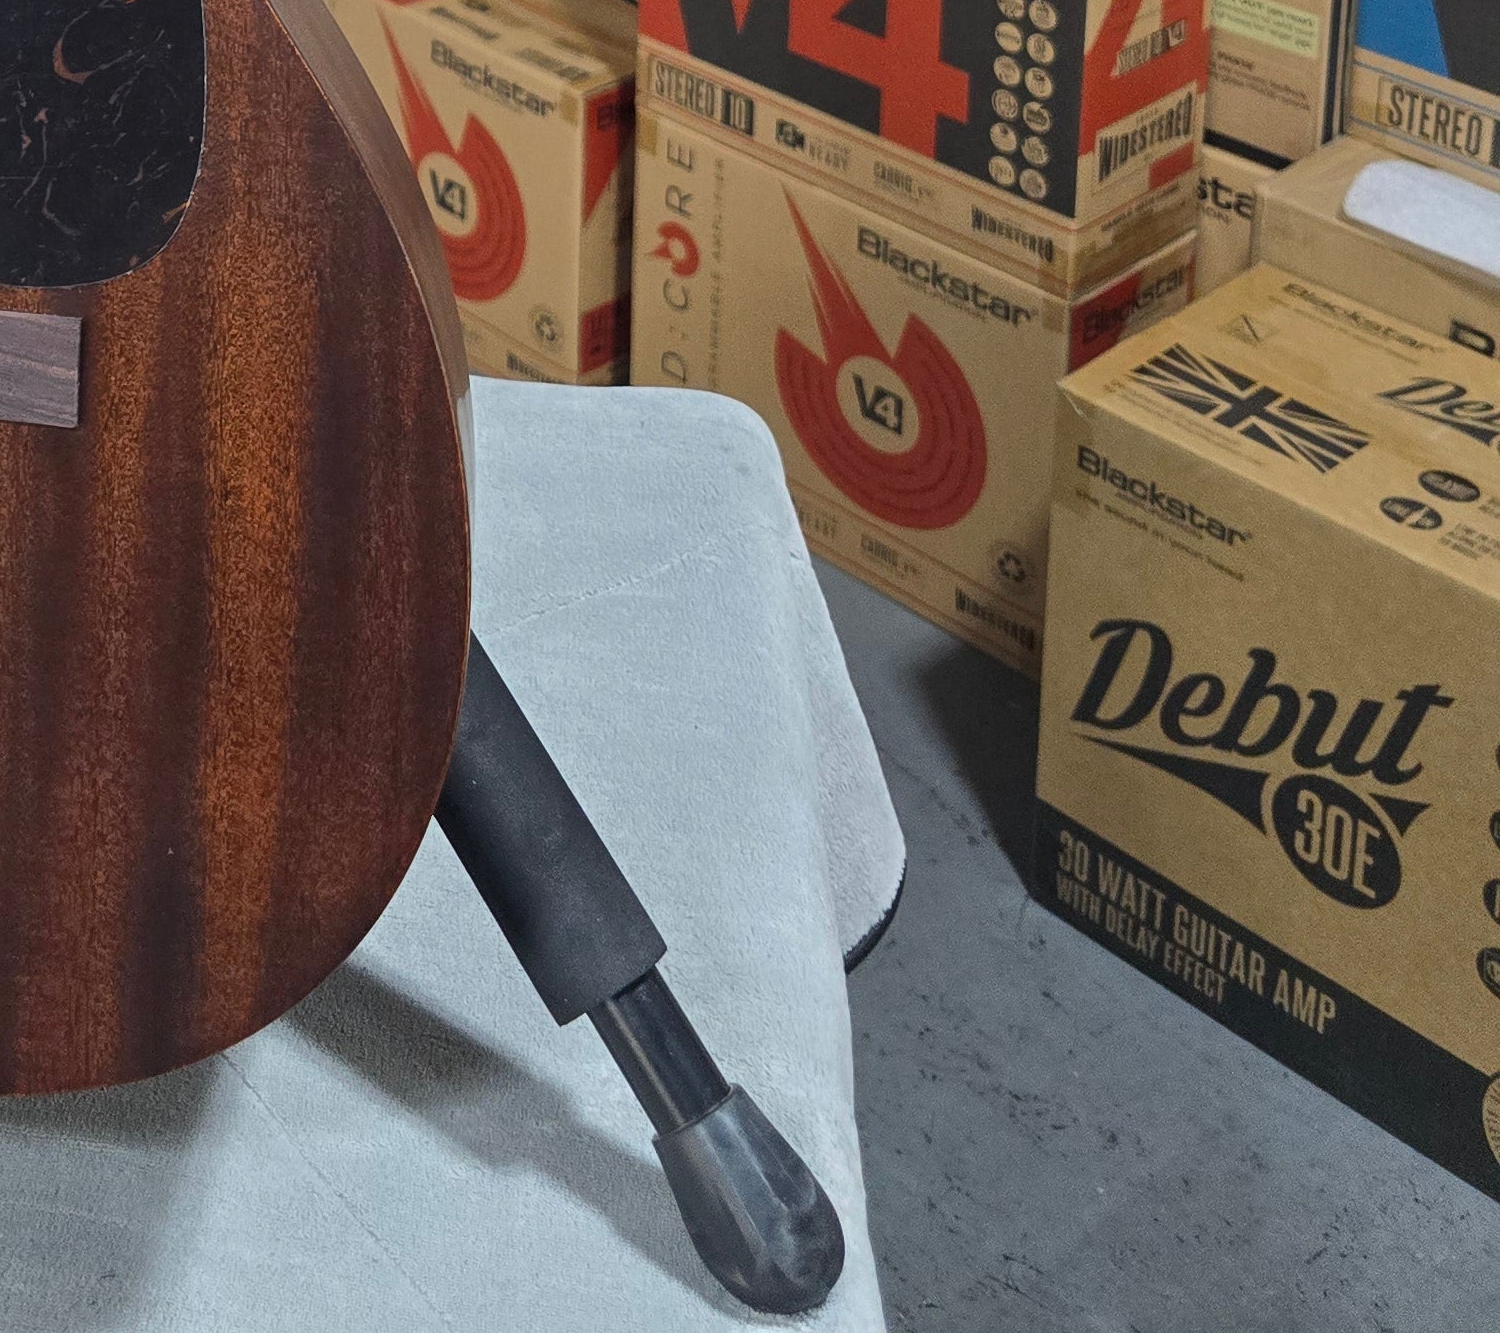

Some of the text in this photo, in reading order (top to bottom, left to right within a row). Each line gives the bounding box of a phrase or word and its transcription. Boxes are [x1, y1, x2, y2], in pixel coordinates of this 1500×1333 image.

[430, 39, 556, 118] Blackstar
[655, 62, 718, 127] STEREO
[1387, 84, 1483, 156] STEREO
[857, 226, 1031, 329] Blackstar
[1077, 444, 1250, 546] Blackstar
[1069, 618, 1456, 786] Debut
[1295, 789, 1380, 901] 30E
[1056, 871, 1228, 1006] WITH DELAY EFFECT
[1059, 830, 1337, 1035] 30 WATT GUITAR AMP
